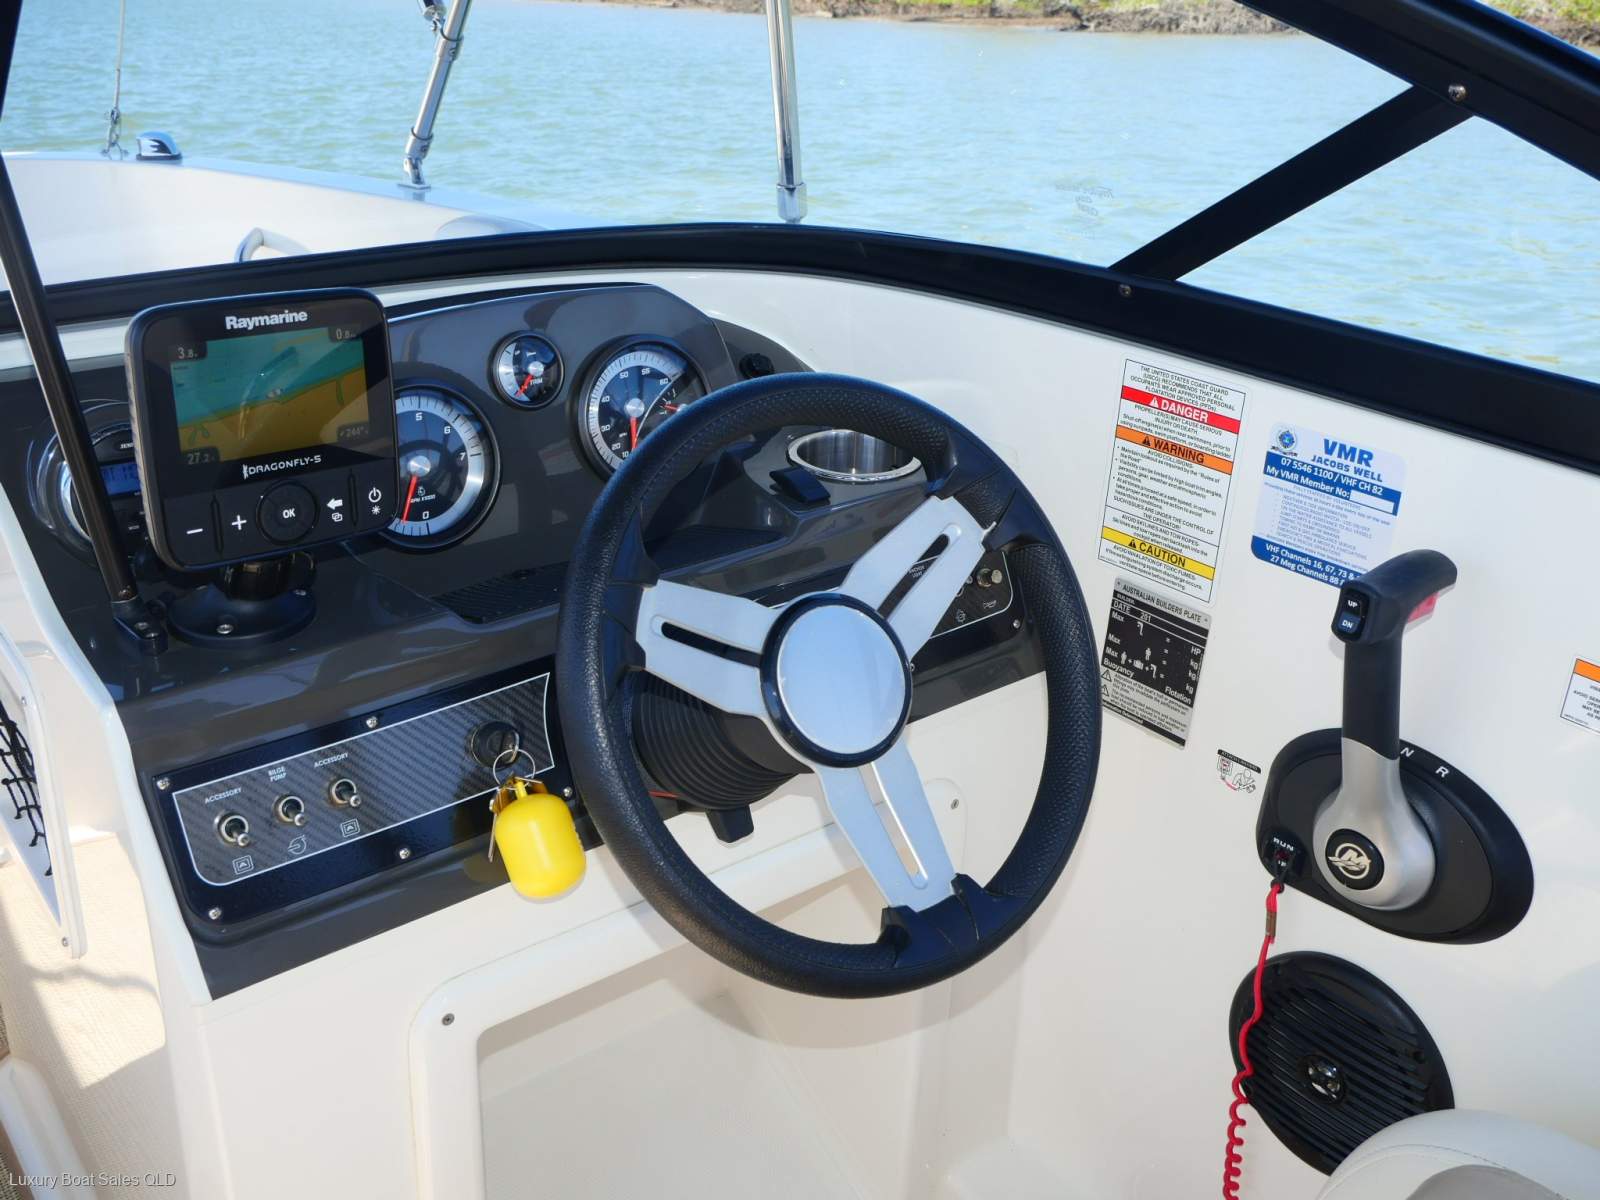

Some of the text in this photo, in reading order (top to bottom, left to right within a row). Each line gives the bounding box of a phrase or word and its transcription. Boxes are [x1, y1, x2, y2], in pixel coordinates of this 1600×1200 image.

[226, 310, 307, 330] Raymarine
[1151, 369, 1170, 378] UNITED
[1171, 375, 1189, 384] STATES
[1190, 380, 1208, 390] COAST
[1210, 386, 1229, 396] GUARD
[1162, 378, 1198, 393] RECOMMENDS
[1199, 389, 1212, 398] THAT
[1214, 393, 1224, 401] ALL
[1130, 376, 1235, 411] OCCUPANTS WEAR APPROVED PERSONAL
[1177, 396, 1199, 407] DEVICES
[416, 413, 422, 421] 5
[1161, 399, 1209, 423] DANGER
[444, 426, 450, 434] 6
[1199, 424, 1222, 436] SERIOUS
[1153, 438, 1204, 464] WARNING
[1324, 438, 1374, 468] VMR
[1311, 455, 1383, 482] JACOBS WELL
[1266, 465, 1279, 477] My
[1281, 470, 1298, 482] VMR
[1300, 475, 1334, 493] Member
[1335, 487, 1350, 498] No:
[1281, 457, 1291, 467] 07
[1293, 460, 1312, 474] 5546
[1314, 467, 1334, 480] 1100
[1341, 475, 1358, 486] VHF
[1359, 481, 1371, 492] CH
[1372, 484, 1384, 496] 82
[283, 508, 296, 519] OK
[1139, 542, 1186, 568] CAUTION
[1266, 543, 1280, 554] VHF
[1281, 546, 1312, 566] Channels
[1313, 559, 1323, 571] 16,
[1338, 568, 1347, 578] 73
[1270, 555, 1339, 585] 27 Meg Channels 88
[1113, 600, 1131, 614] DATE
[1123, 583, 1201, 624] AUSTRALIAN BUILDERS PLATE
[1348, 600, 1358, 608] UP
[1112, 610, 1124, 622] Max
[1342, 620, 1353, 628] DN
[1108, 633, 1121, 645] Max
[1105, 646, 1119, 658] Max
[1190, 646, 1201, 656] HP
[1103, 657, 1134, 679] Buoyancy
[1189, 659, 1199, 671] kg
[1187, 670, 1196, 681] kg
[1165, 686, 1192, 705] Flotation
[1185, 684, 1194, 695] kg
[313, 752, 348, 768] ACCESSORY
[1400, 747, 1414, 759] N
[268, 766, 285, 777] BILGE
[270, 773, 287, 782] PUMP
[1436, 766, 1449, 778] R
[204, 787, 242, 804] ACCESSORY
[1274, 836, 1294, 851] RUN
